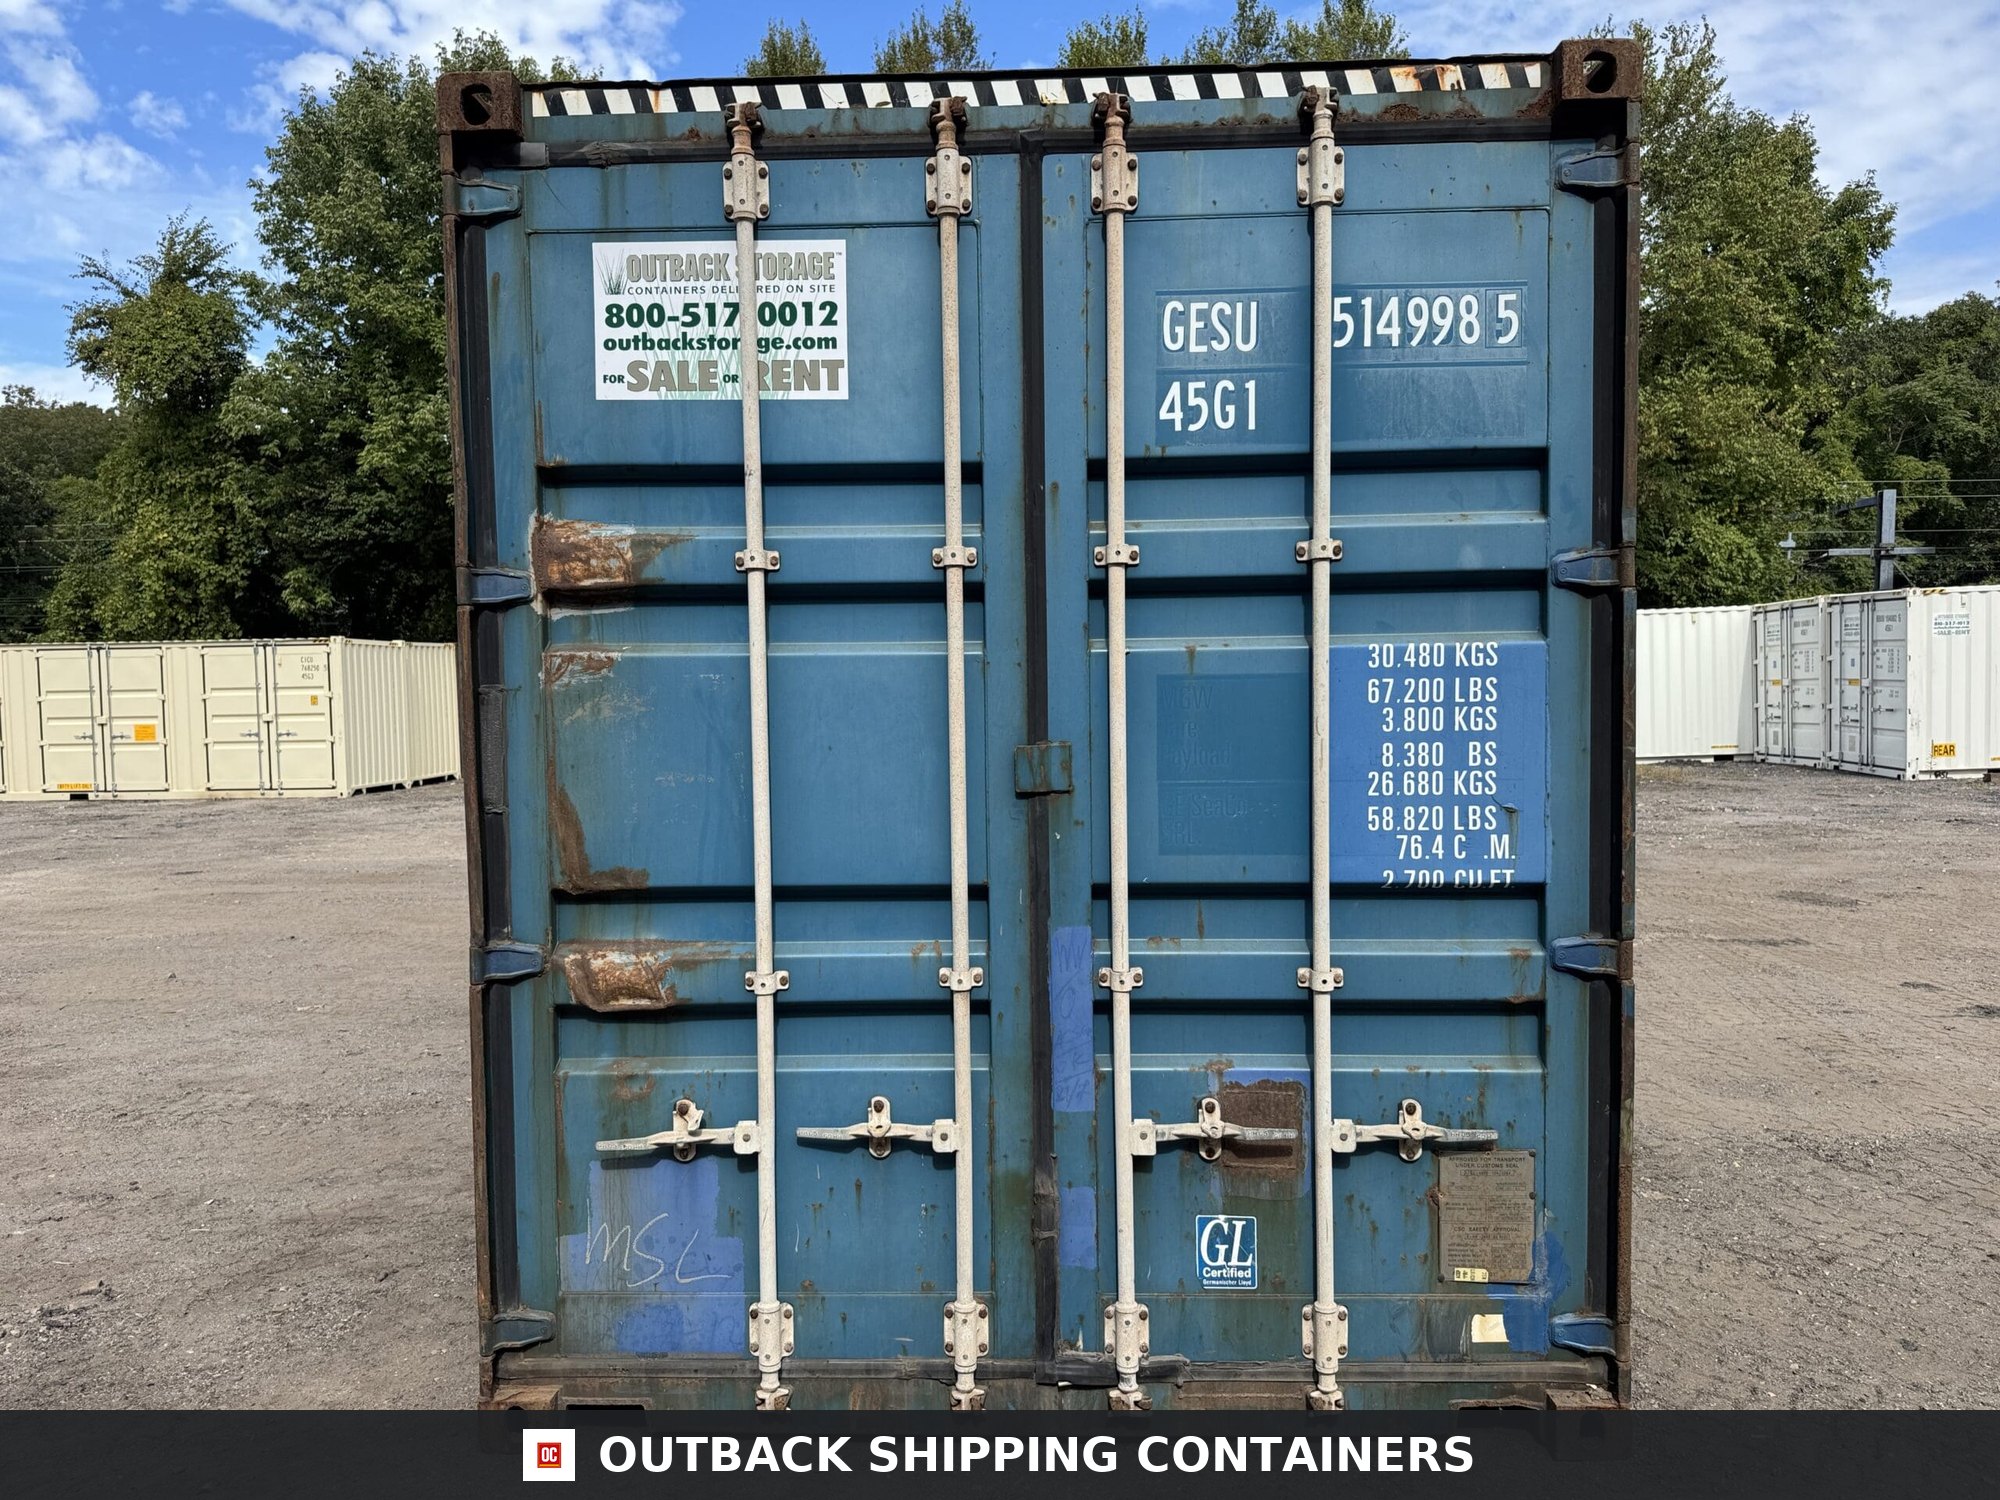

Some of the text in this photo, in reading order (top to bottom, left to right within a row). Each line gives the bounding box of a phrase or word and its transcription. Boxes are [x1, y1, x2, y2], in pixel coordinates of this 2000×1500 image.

[626, 251, 836, 283] OUTBACK TORAGE
[627, 284, 836, 295] CONTAINERS DELIRED ON SITE
[604, 301, 838, 328] 800-5170012
[1162, 293, 1520, 353] GESU 514998 5
[603, 332, 838, 354] outbackstorge.com
[602, 374, 625, 384] FOR
[626, 359, 719, 392] SALE
[723, 374, 739, 384] OR
[1159, 379, 1257, 432] 45G1
[1367, 641, 1499, 668] 30,480 KGS
[1367, 676, 1498, 704] 67,200 LBS
[1382, 705, 1497, 732] 3,800 KGS
[1381, 742, 1444, 768] 8,380
[1933, 744, 1955, 756] REAR
[1367, 770, 1497, 797] 26,680 KGS
[1367, 805, 1497, 832] 58,820 LBS
[1396, 834, 1445, 860] 76.4
[1200, 1219, 1253, 1267] GL
[1202, 1267, 1252, 1278] Certified
